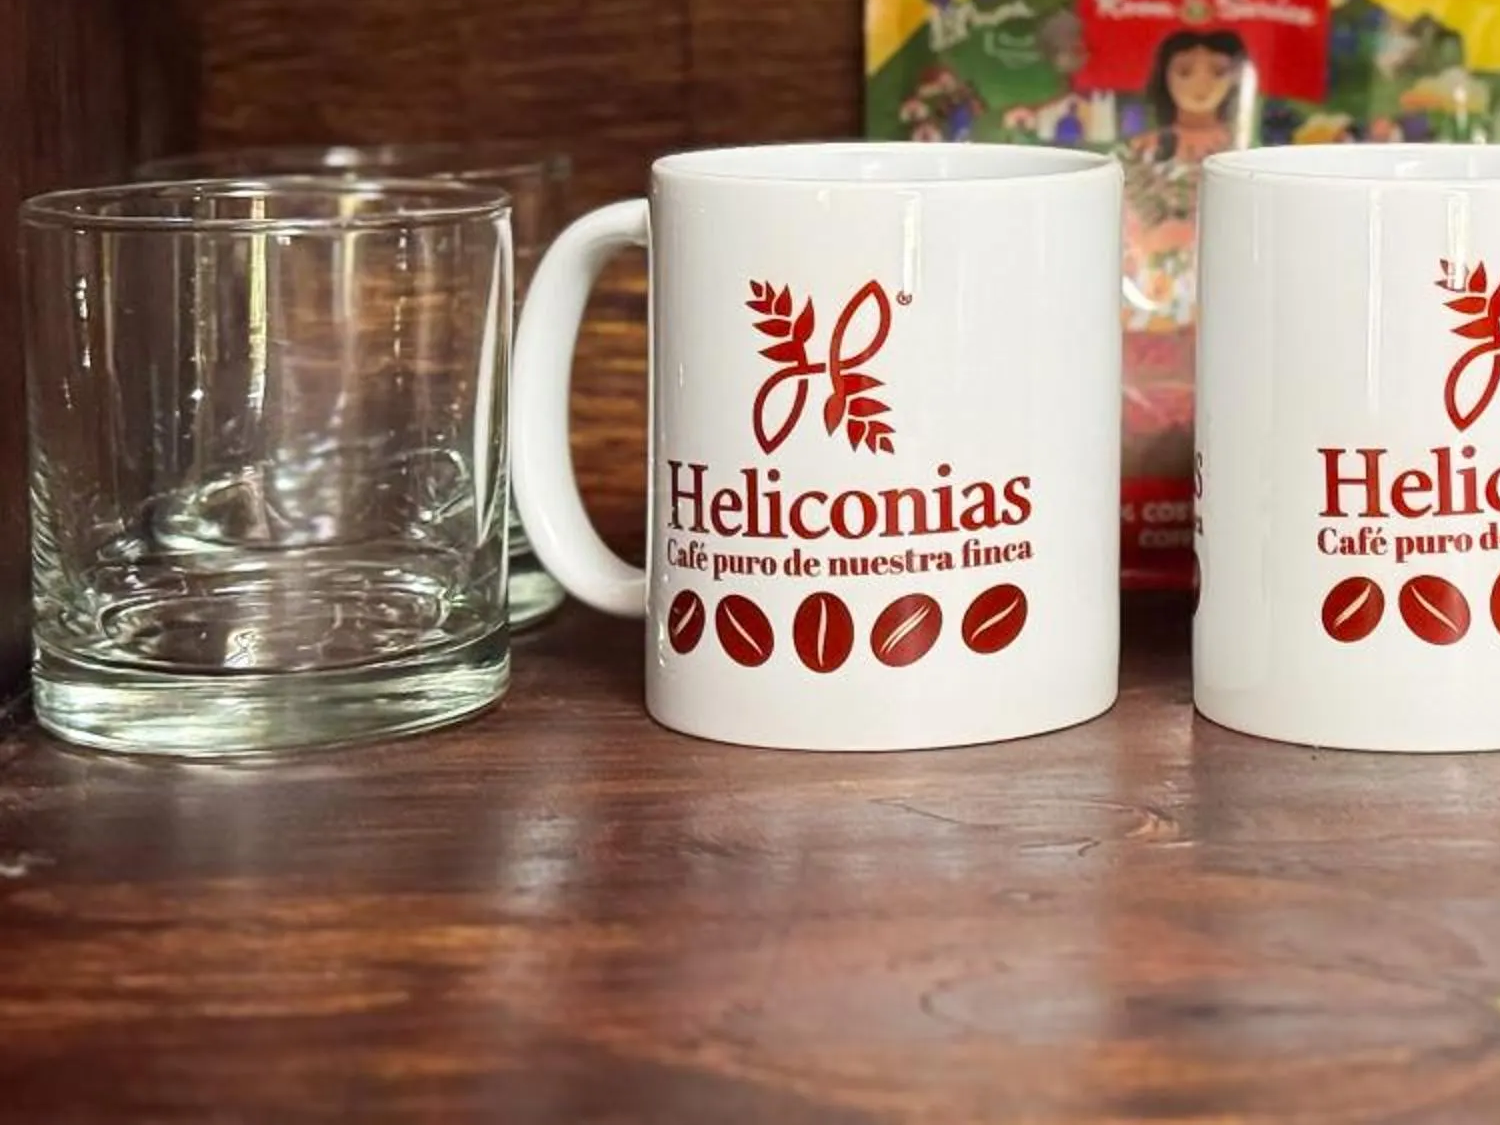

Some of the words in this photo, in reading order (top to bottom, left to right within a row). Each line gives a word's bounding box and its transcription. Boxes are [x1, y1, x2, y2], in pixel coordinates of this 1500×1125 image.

[667, 460, 1032, 540] Heliconias
[667, 538, 709, 572] Café
[713, 553, 777, 581] puro
[783, 548, 821, 577] de
[828, 549, 955, 577] nuestra
[961, 538, 1034, 568] finca
[1317, 526, 1387, 556] Café
[1395, 533, 1472, 563] puro
